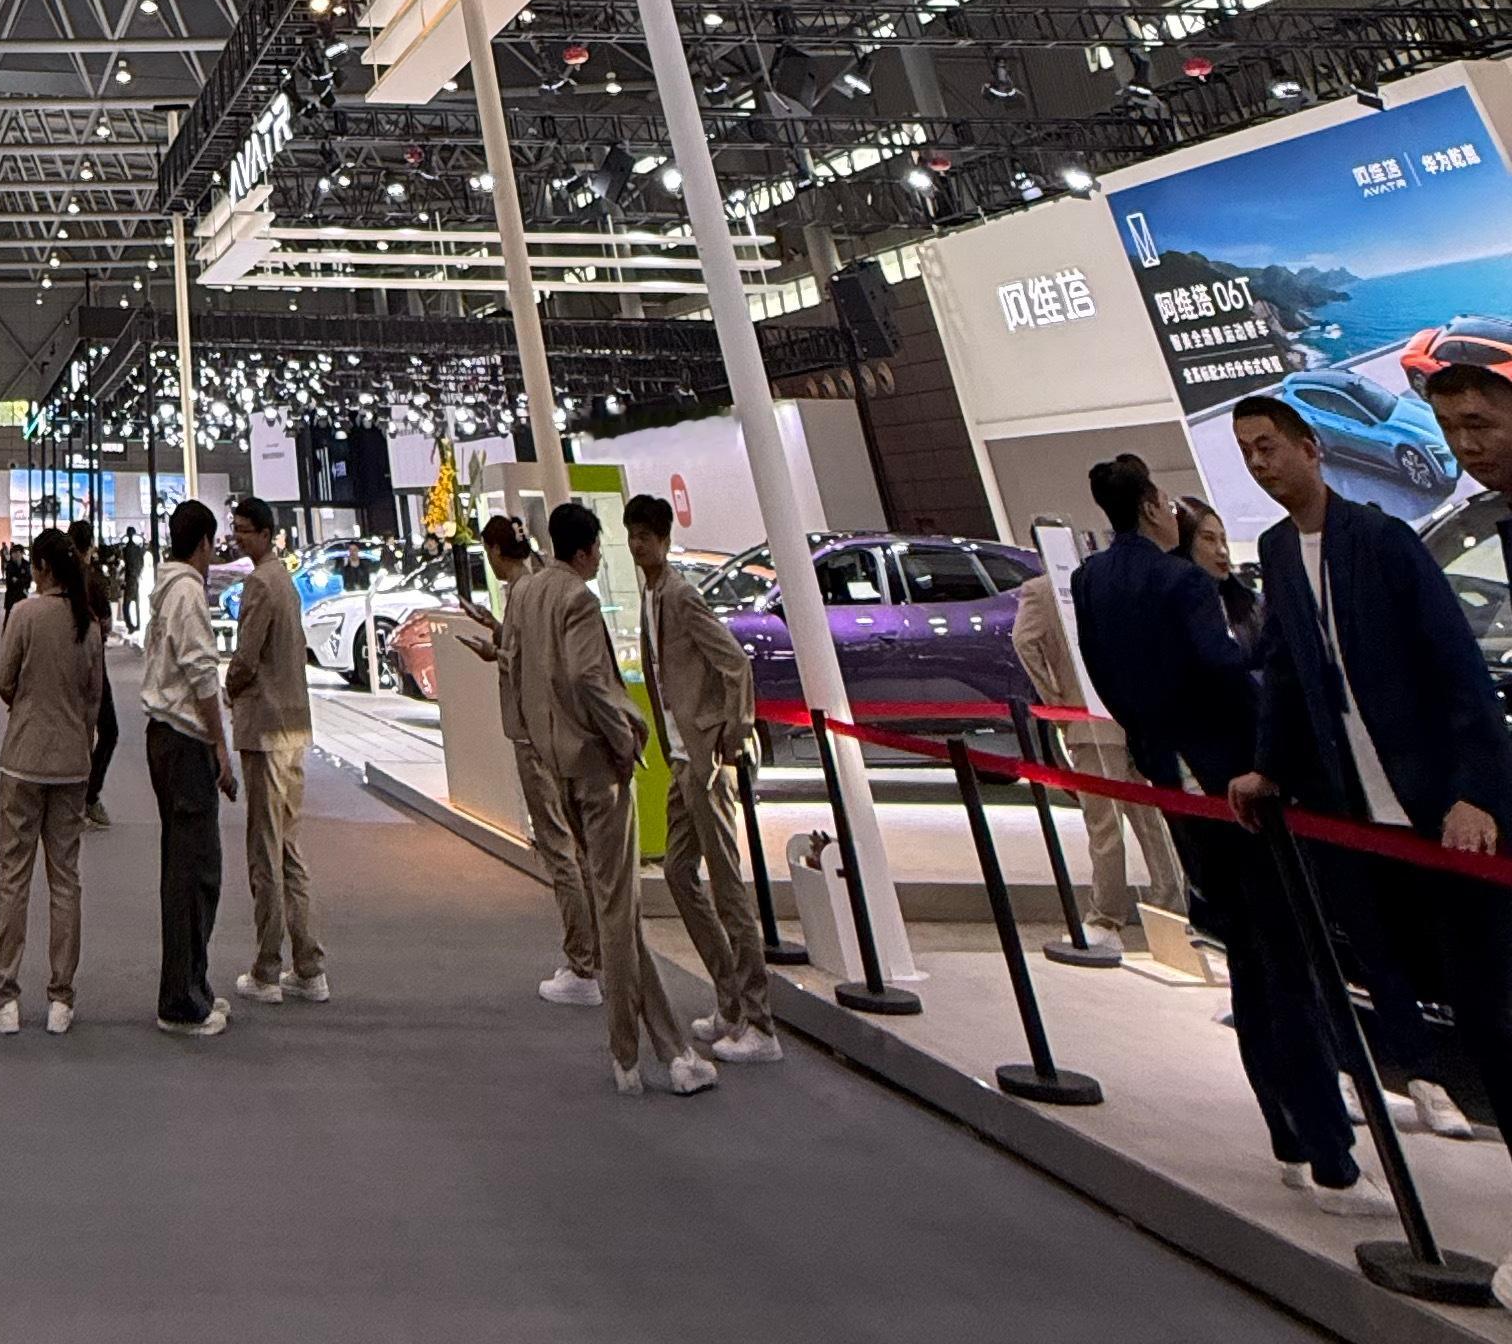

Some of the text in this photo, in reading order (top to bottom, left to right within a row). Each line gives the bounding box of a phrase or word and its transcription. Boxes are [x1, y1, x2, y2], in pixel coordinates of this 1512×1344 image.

[1363, 178, 1407, 198] AVATR
[997, 267, 1096, 333] 阿维塔
[1154, 276, 1254, 326] 阿维塔 06T
